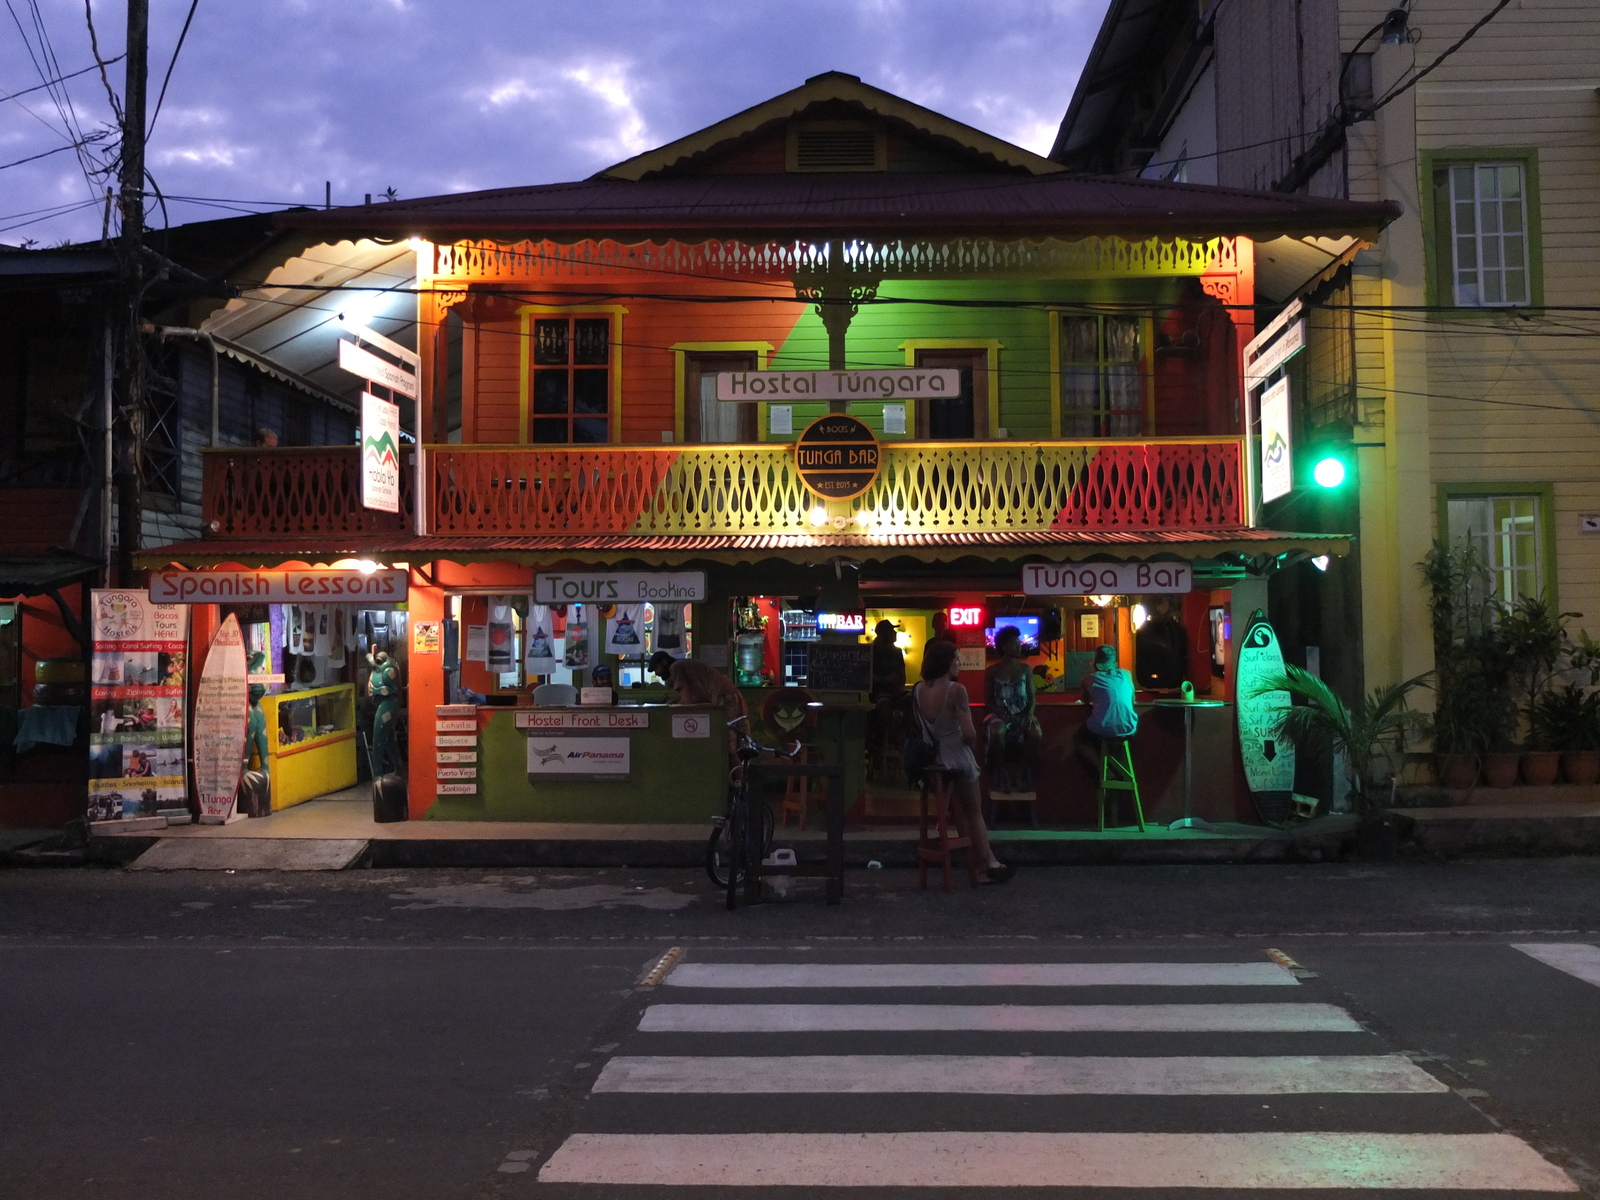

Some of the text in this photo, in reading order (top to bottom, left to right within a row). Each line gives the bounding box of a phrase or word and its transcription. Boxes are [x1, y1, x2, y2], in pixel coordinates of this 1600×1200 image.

[731, 372, 945, 397] Hostal Túngara
[799, 450, 877, 465] TUNGA BAR
[1028, 564, 1185, 593] Tunga Bar
[163, 573, 395, 600] Spanish Lessons
[546, 576, 618, 599] Tours
[100, 594, 138, 608] Tungara
[950, 607, 980, 627] EXIT
[155, 621, 177, 629] Tours
[103, 624, 138, 638] Hostels
[95, 643, 117, 651] Sailing
[1243, 651, 1260, 662] Surf
[95, 689, 117, 697] Caving
[126, 689, 155, 697] Ziplining
[1243, 702, 1259, 713] Surf
[528, 714, 638, 726] Hostel Front Desk
[1249, 714, 1263, 725] Surf
[438, 769, 475, 778] Puerto Viejo
[123, 780, 157, 788] Snorkeling
[442, 785, 471, 794] Santiago
